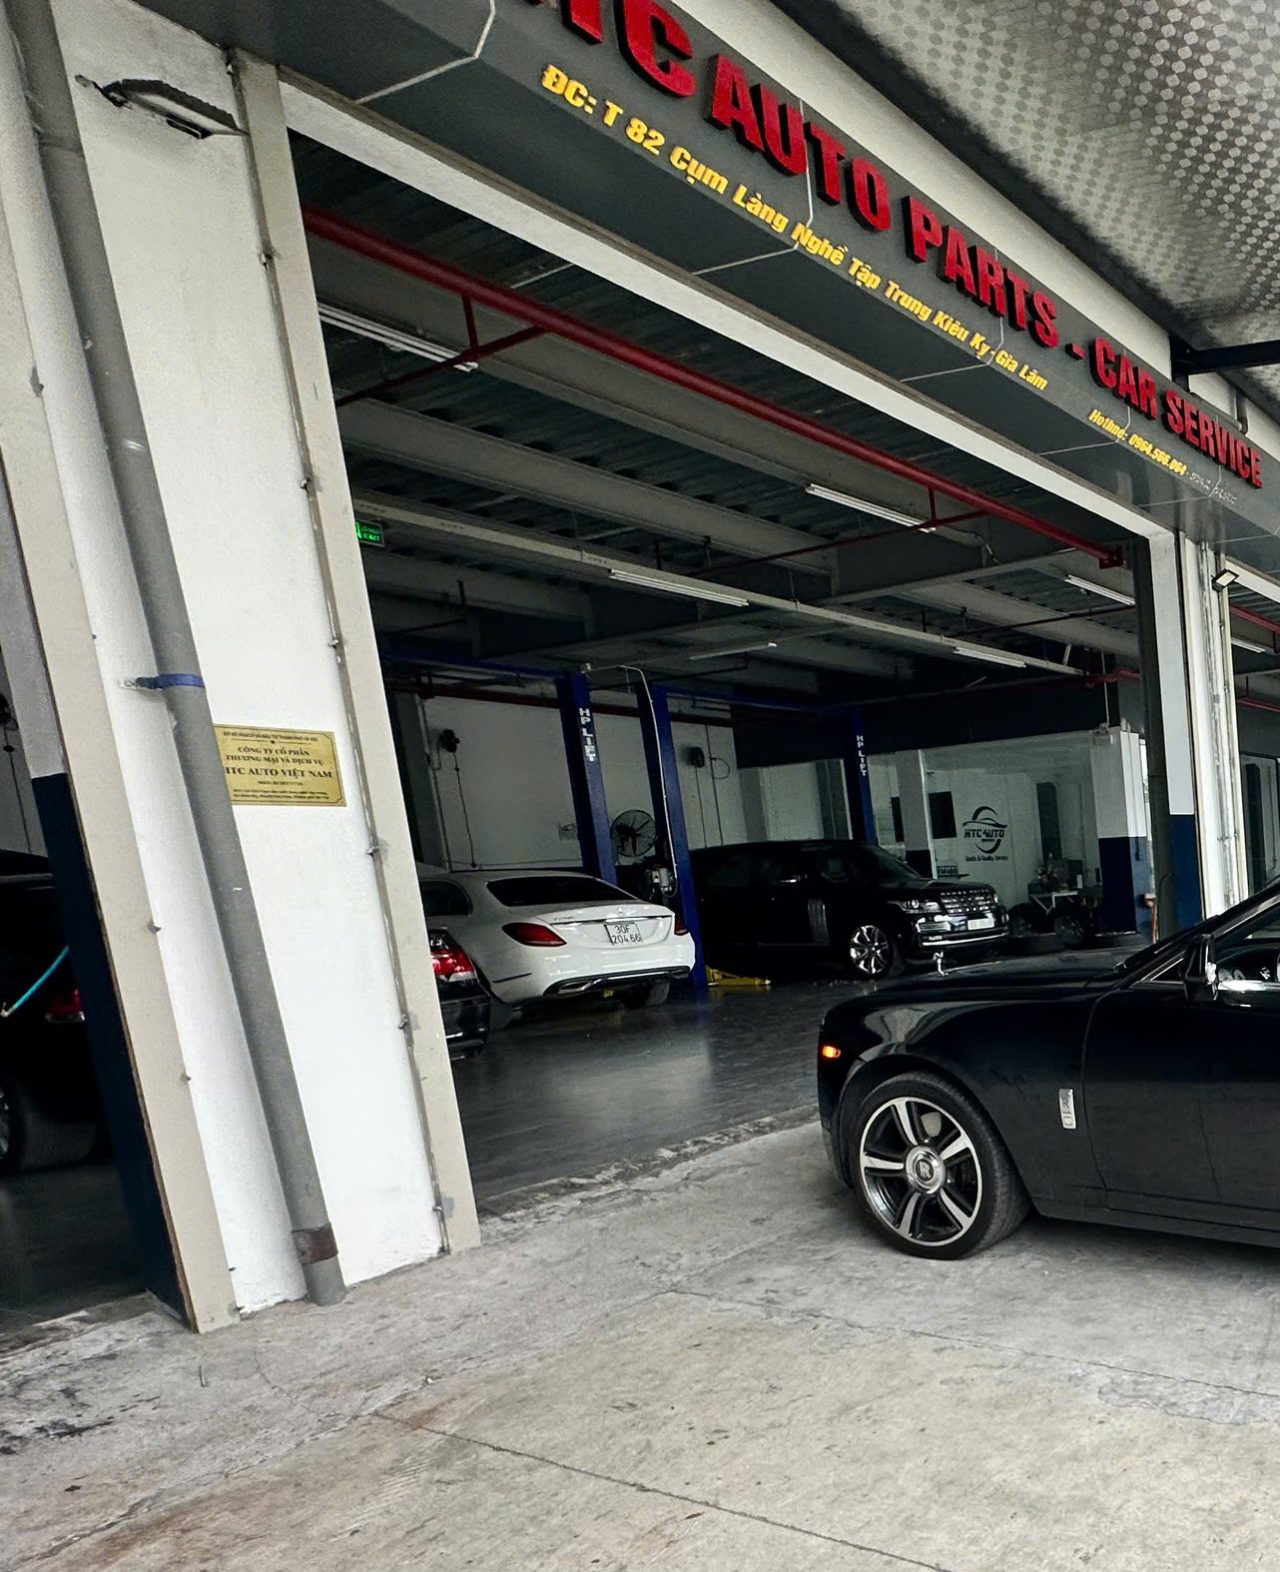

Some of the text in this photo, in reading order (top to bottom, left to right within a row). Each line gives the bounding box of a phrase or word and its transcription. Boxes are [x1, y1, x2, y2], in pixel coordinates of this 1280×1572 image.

[541, 64, 597, 115] ĐC:
[602, 99, 624, 127] T
[625, 117, 666, 156] 82
[669, 146, 729, 195] Cụm
[732, 184, 790, 233] Làng
[791, 222, 849, 266] Nghề
[849, 257, 882, 290] Tập
[884, 280, 933, 322] Trung
[995, 350, 1019, 374] Gia
[1018, 363, 1049, 391] Lâm
[706, 53, 892, 232] AUTO
[903, 195, 1059, 348] PARTS
[1093, 336, 1158, 420] CAR
[1163, 389, 1263, 489] SERVICE
[1088, 409, 1129, 441] Hotline:
[579, 707, 592, 726] HP
[238, 745, 262, 754] CÔNG
[263, 747, 274, 755] TY
[248, 767, 279, 777] AUTO
[280, 768, 306, 780] VIỆT
[308, 769, 333, 779] NAM
